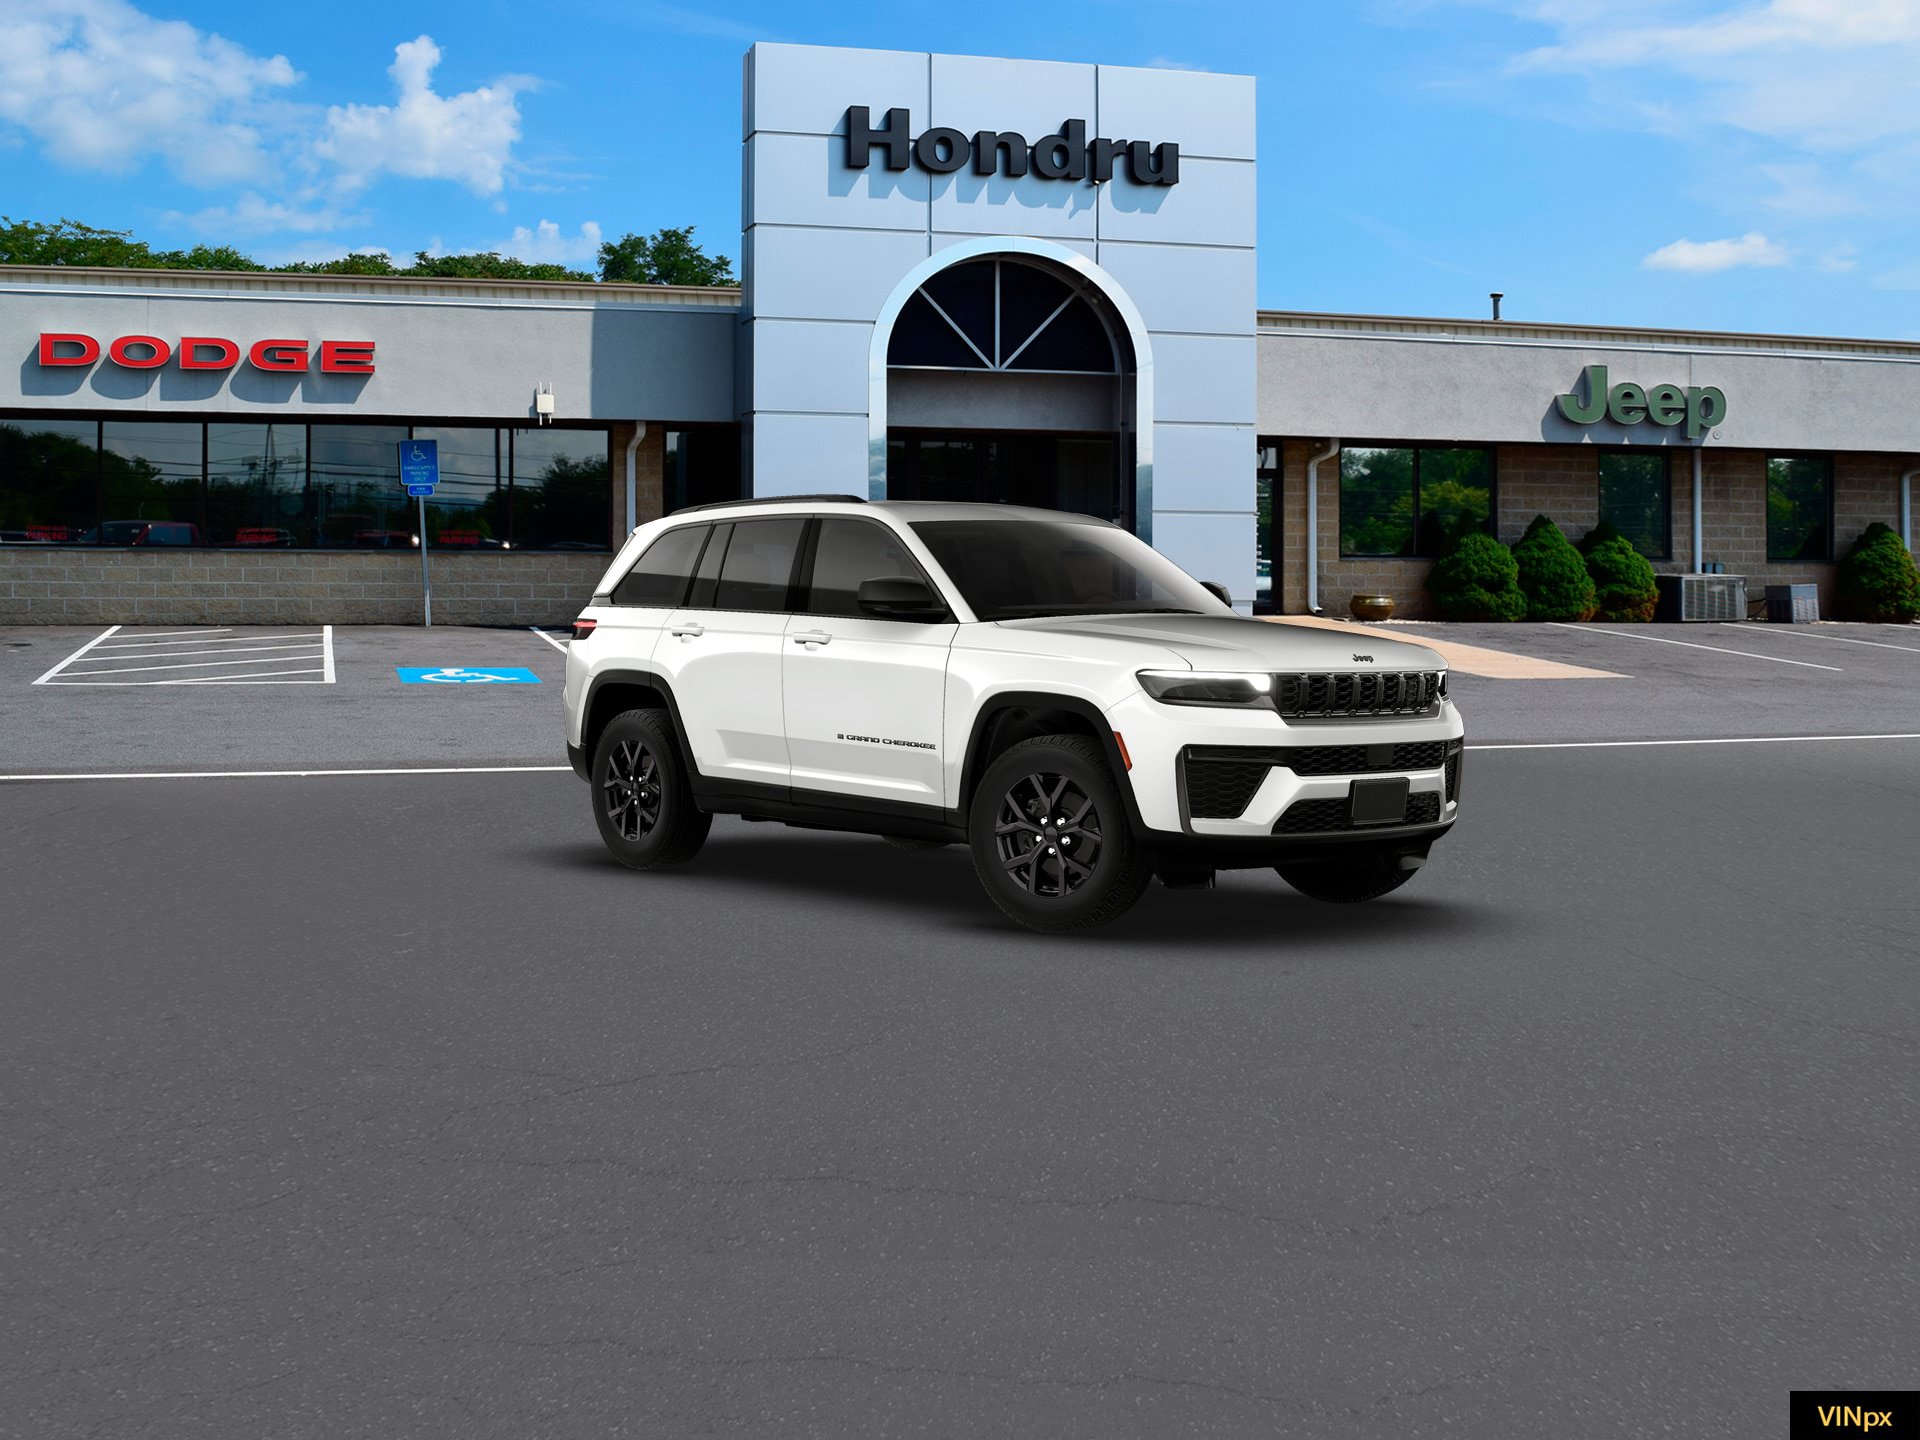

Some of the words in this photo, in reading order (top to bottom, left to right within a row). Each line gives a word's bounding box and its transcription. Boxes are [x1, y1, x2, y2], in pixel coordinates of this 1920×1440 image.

[845, 105, 1179, 185] Hondru
[39, 332, 375, 373] DODGE
[1556, 365, 1726, 439] Jeep
[1352, 654, 1374, 663] Jeep
[846, 734, 880, 743] GRAND
[882, 738, 936, 750] CHEROKEE
